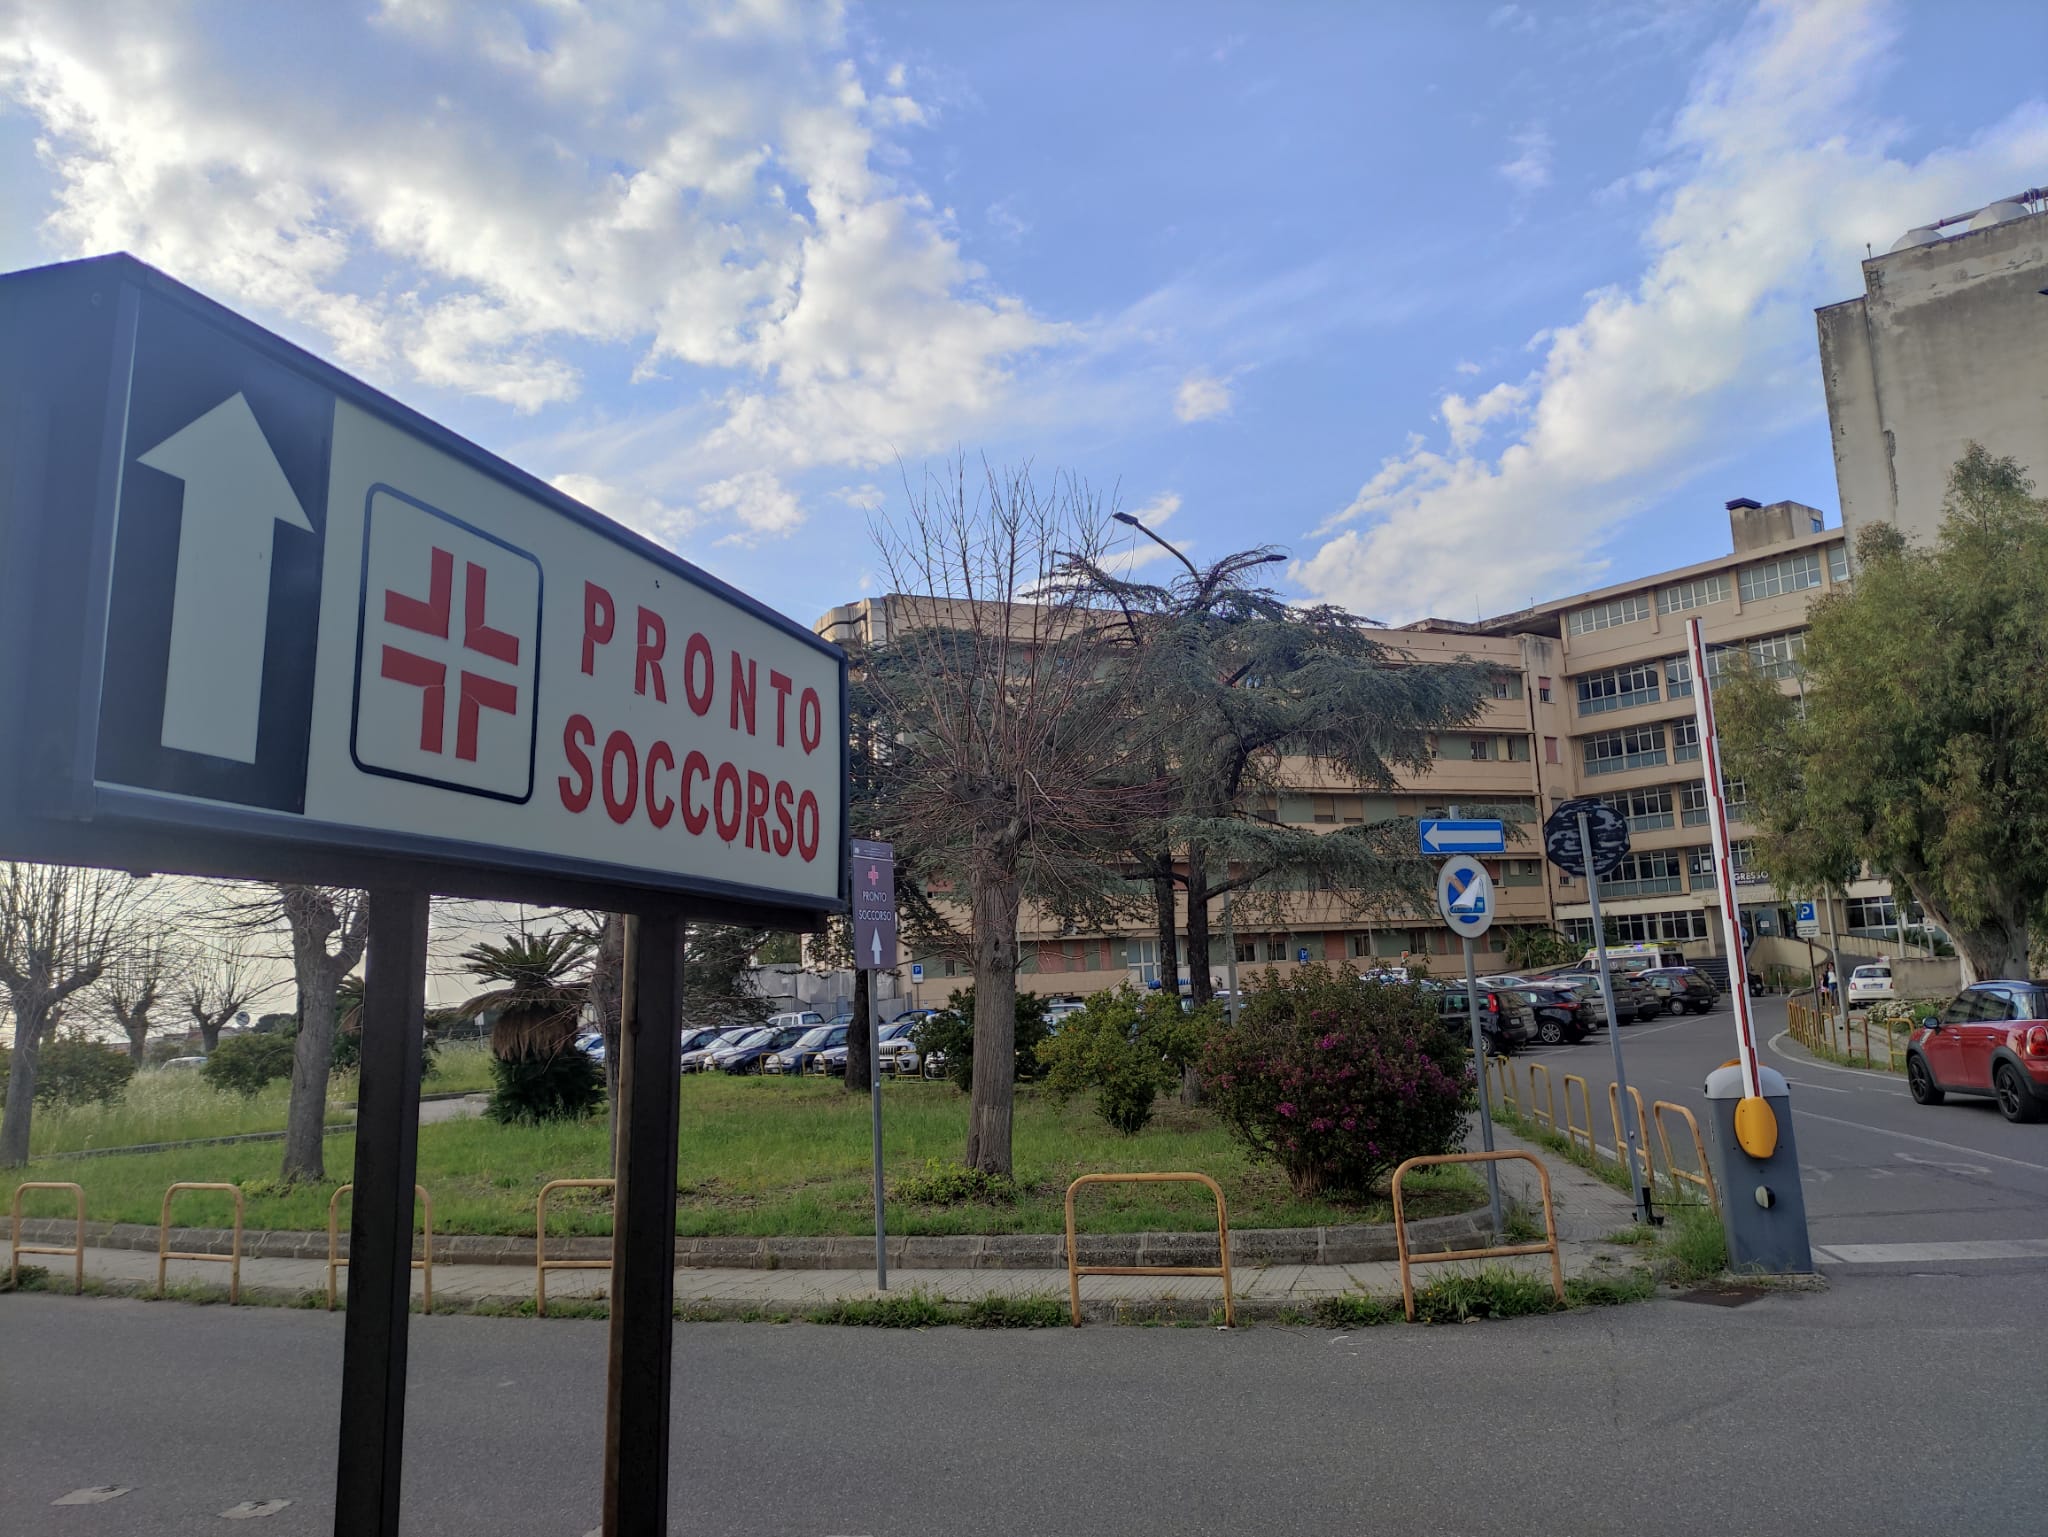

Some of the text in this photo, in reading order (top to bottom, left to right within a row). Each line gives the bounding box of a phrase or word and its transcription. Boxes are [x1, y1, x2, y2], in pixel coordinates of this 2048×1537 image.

[581, 580, 821, 756] PRONTO
[558, 714, 820, 863] SOCCORSO
[1734, 871, 1769, 881] GRESO
[862, 890, 887, 902] PRONTO
[858, 909, 892, 921] SOCCORSO
[1800, 906, 1810, 919] P
